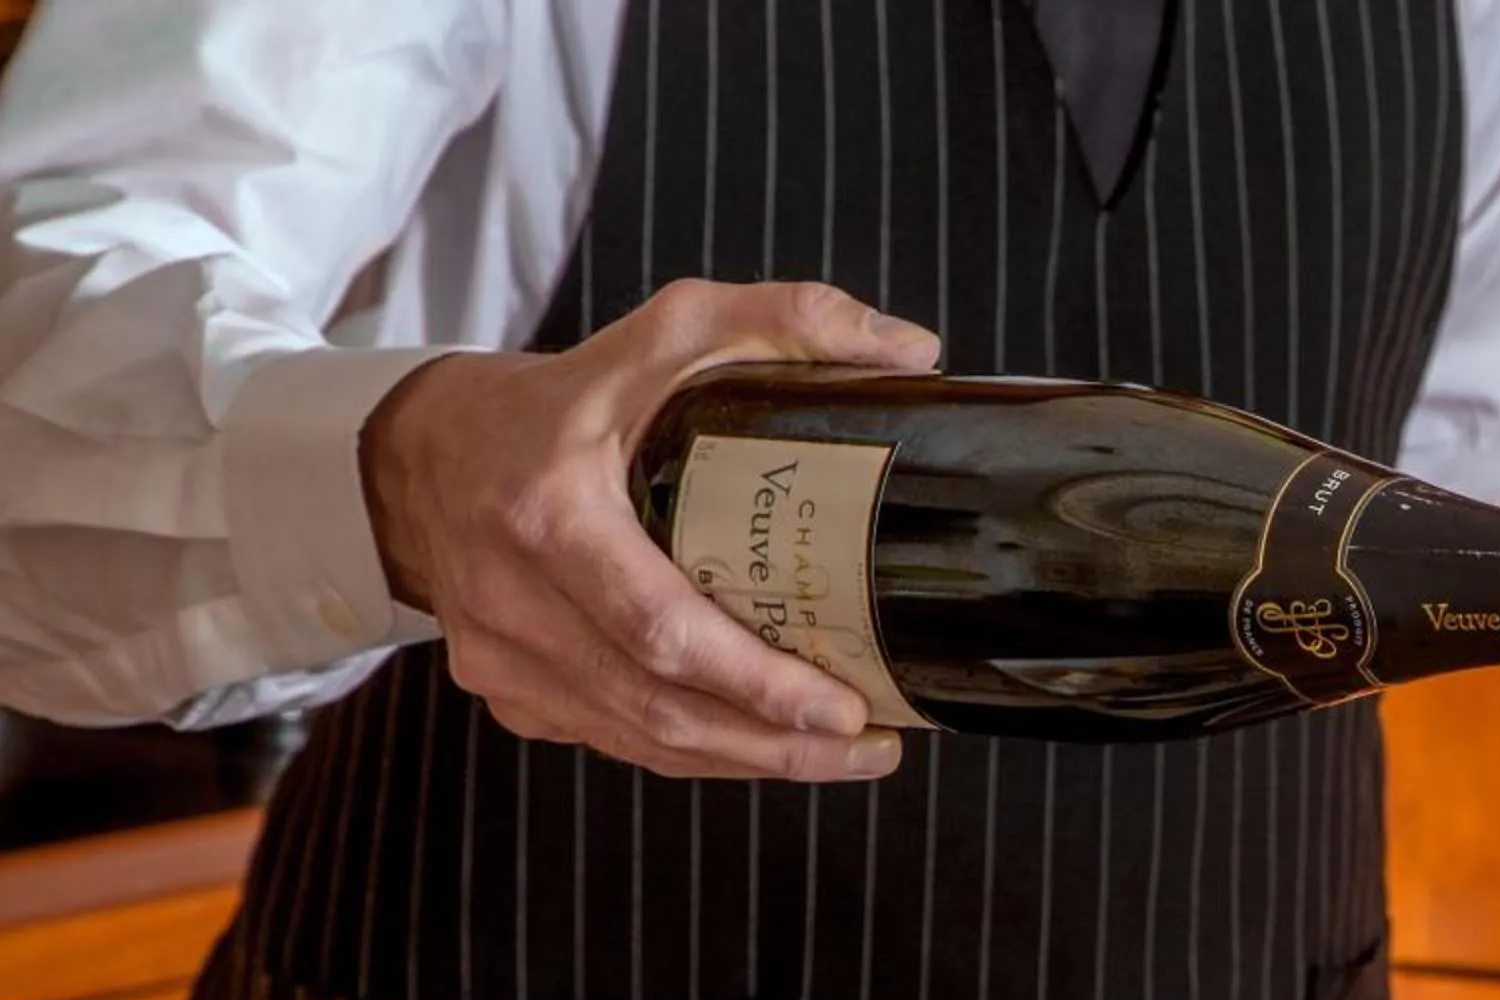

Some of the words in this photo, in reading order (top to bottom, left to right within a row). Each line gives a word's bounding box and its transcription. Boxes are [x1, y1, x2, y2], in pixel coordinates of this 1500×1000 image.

[749, 460, 798, 583] Veuve
[1309, 469, 1351, 516] BRUT
[793, 499, 832, 672] CHAMPAG
